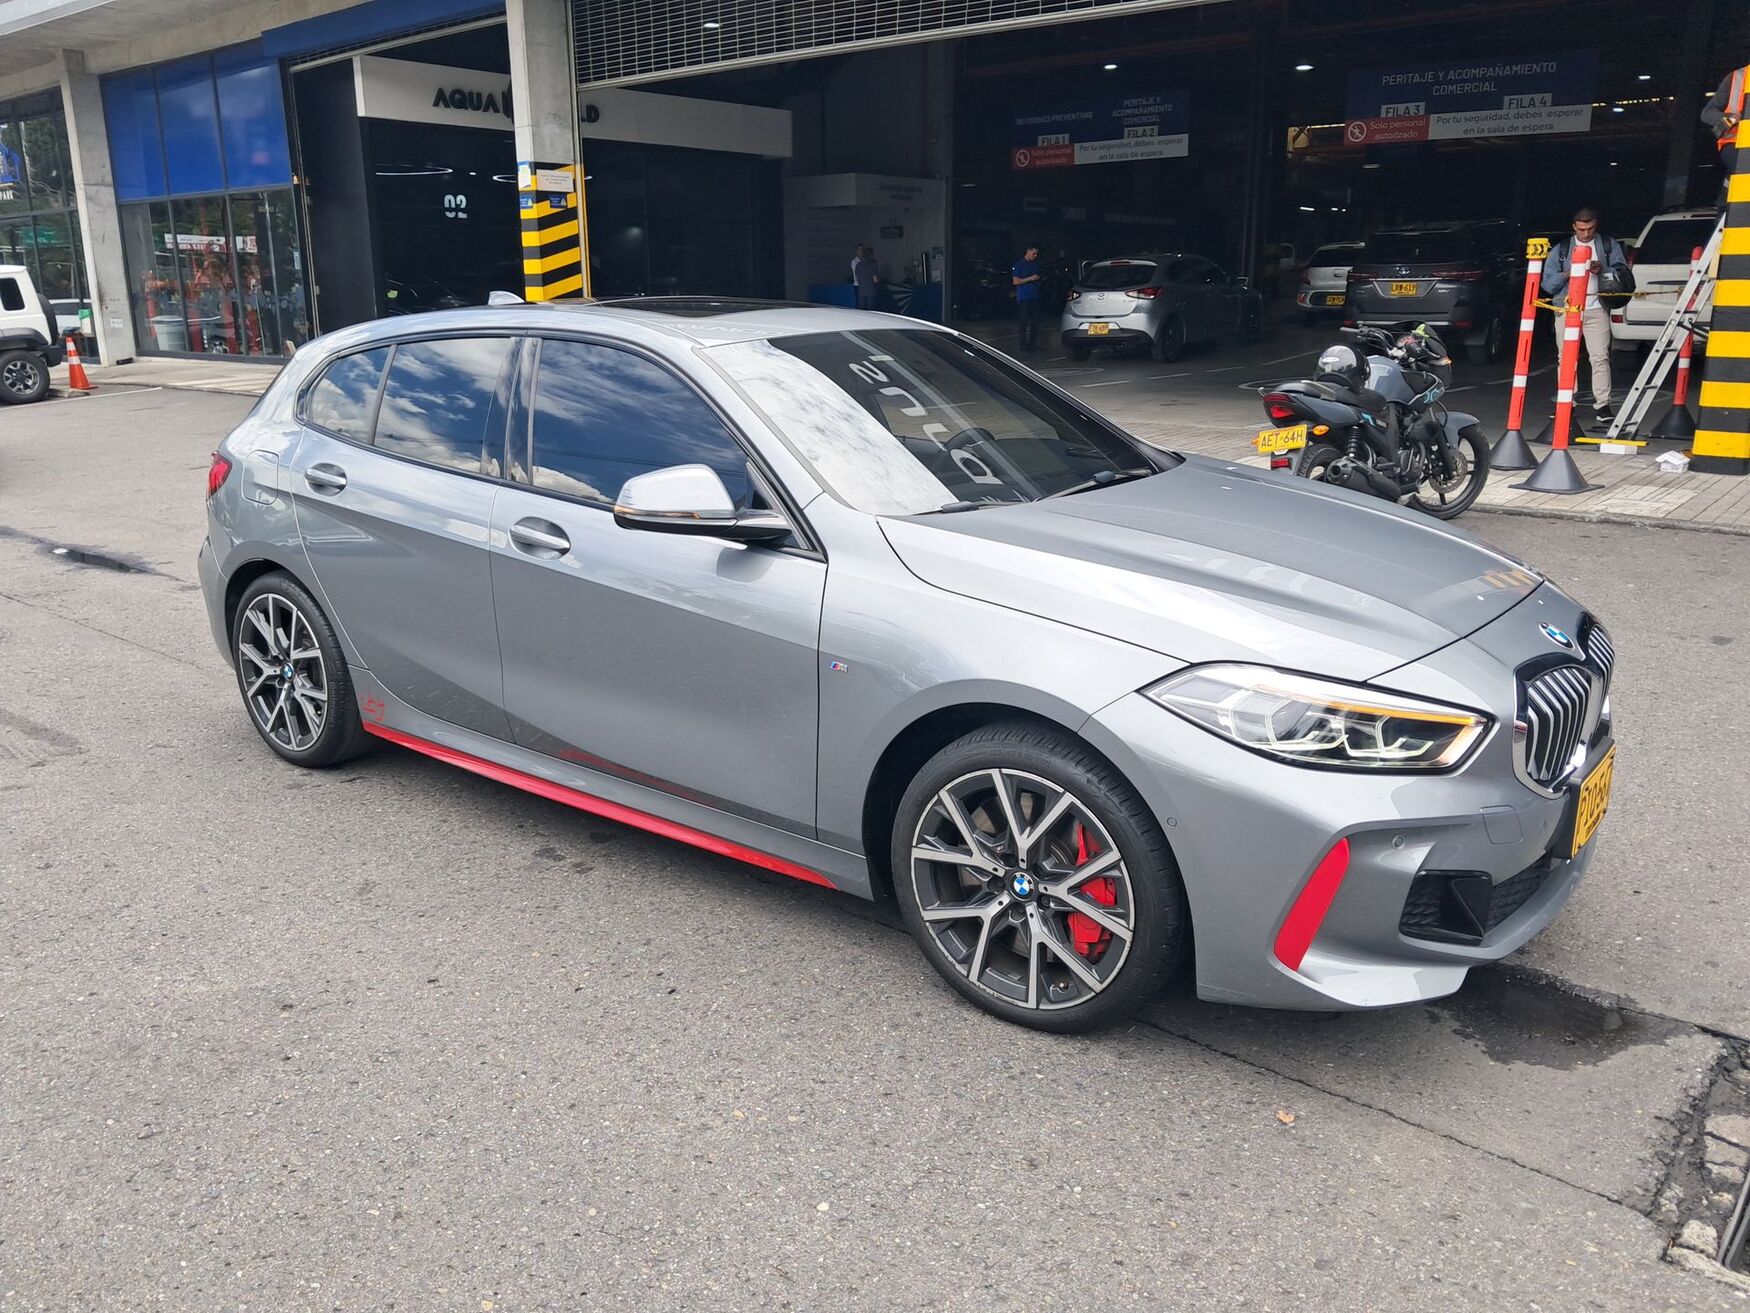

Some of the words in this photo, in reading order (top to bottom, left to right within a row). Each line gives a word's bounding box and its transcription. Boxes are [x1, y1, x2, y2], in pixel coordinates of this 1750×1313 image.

[1382, 71, 1436, 86] PERITAJE
[1438, 71, 1445, 79] Y
[1447, 62, 1557, 81] ACOMPAÑAMIENTO
[1432, 81, 1497, 96] COMERCIAL
[432, 87, 501, 114] AQUA
[1508, 97, 1536, 109] FILA
[1539, 96, 1547, 107] 4
[1385, 106, 1411, 118] FILA
[1413, 105, 1420, 115] 3
[1436, 116, 1451, 125] Por
[1453, 115, 1462, 124] tu
[1464, 113, 1512, 124] seguridad,
[1513, 110, 1542, 120] debes
[1546, 109, 1584, 119] esperar
[1370, 121, 1388, 130] Solo
[1389, 118, 1426, 129] personal
[1463, 128, 1475, 136] en
[1477, 126, 1485, 135] la
[1487, 125, 1505, 134] sala
[1507, 124, 1519, 133] de
[1521, 124, 1554, 134] espera
[1127, 129, 1148, 138] FILA
[1375, 129, 1418, 140] autorizado
[444, 194, 468, 219] 02
